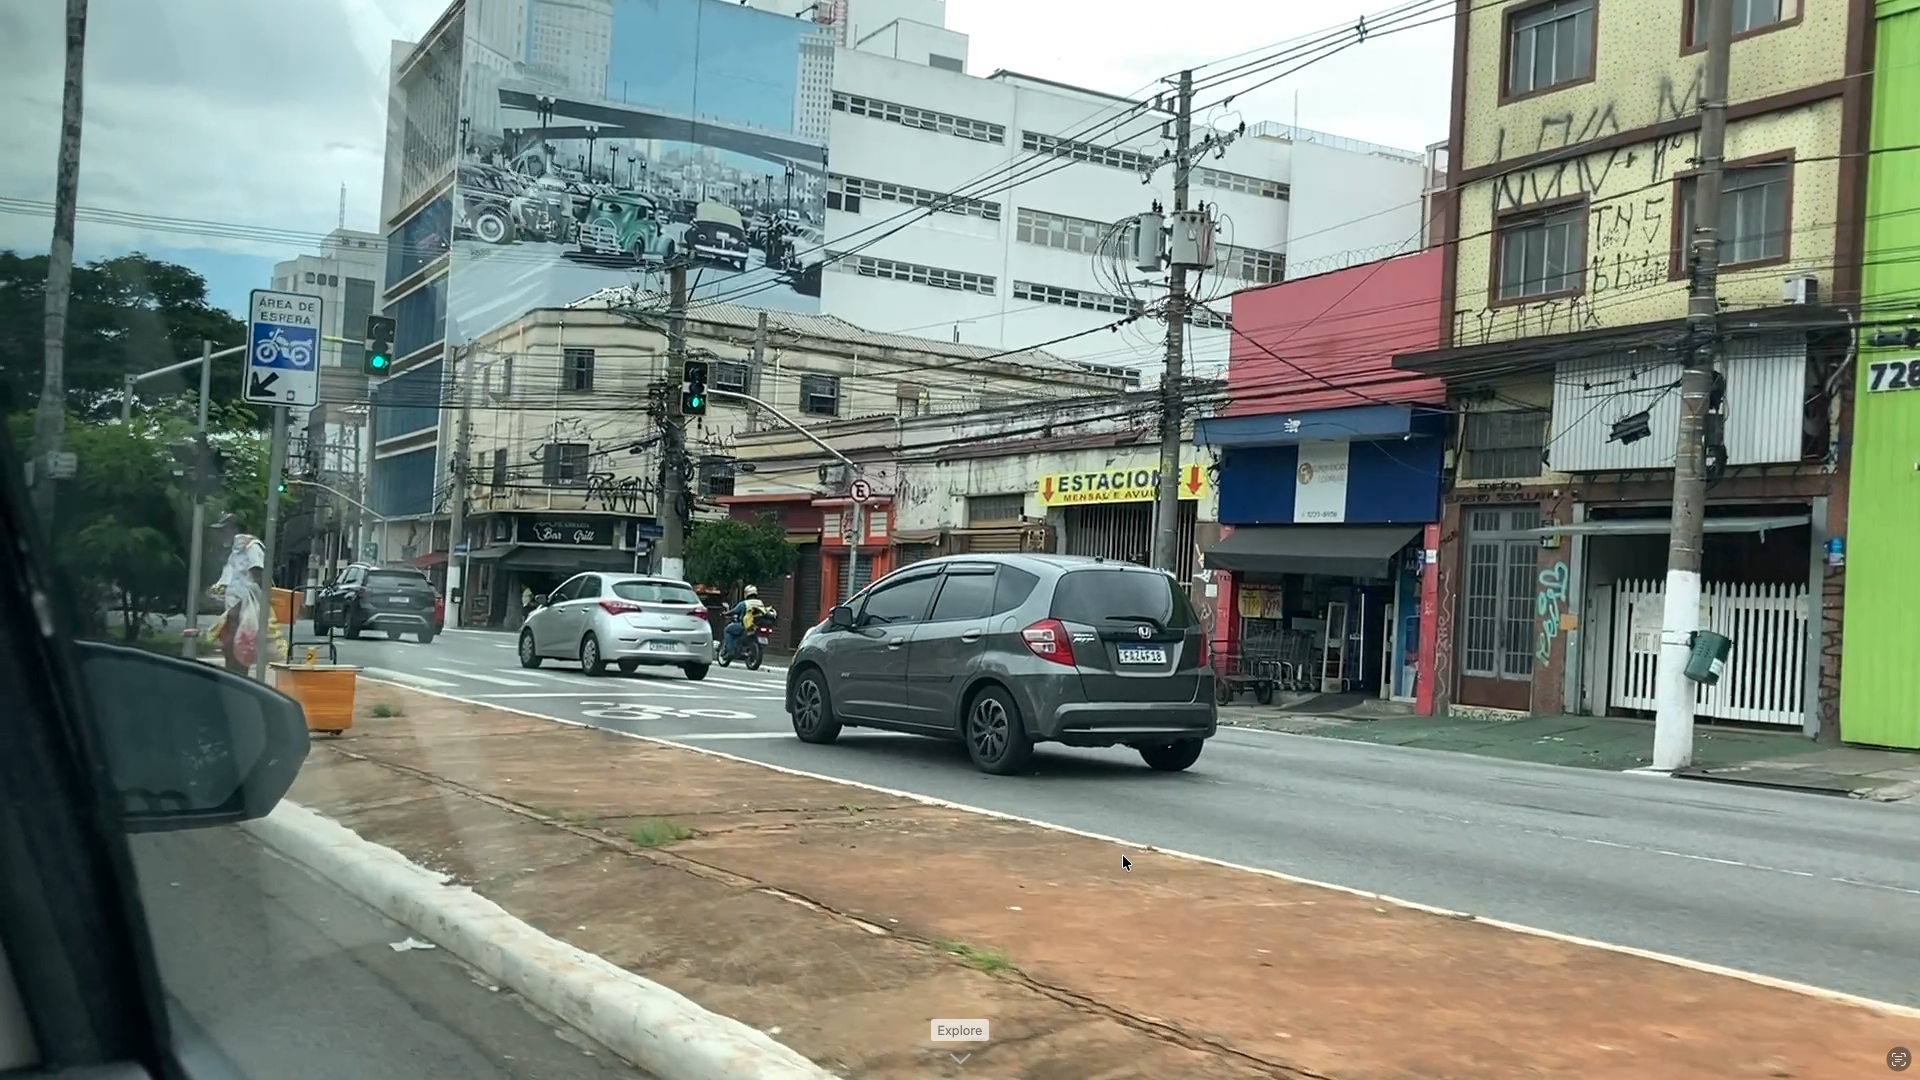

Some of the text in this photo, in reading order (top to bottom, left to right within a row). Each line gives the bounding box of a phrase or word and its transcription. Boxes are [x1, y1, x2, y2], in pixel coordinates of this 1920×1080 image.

[260, 297, 315, 312] ÁREA DE
[261, 311, 311, 325] ESPERA
[543, 526, 596, 544] Bar Grill
